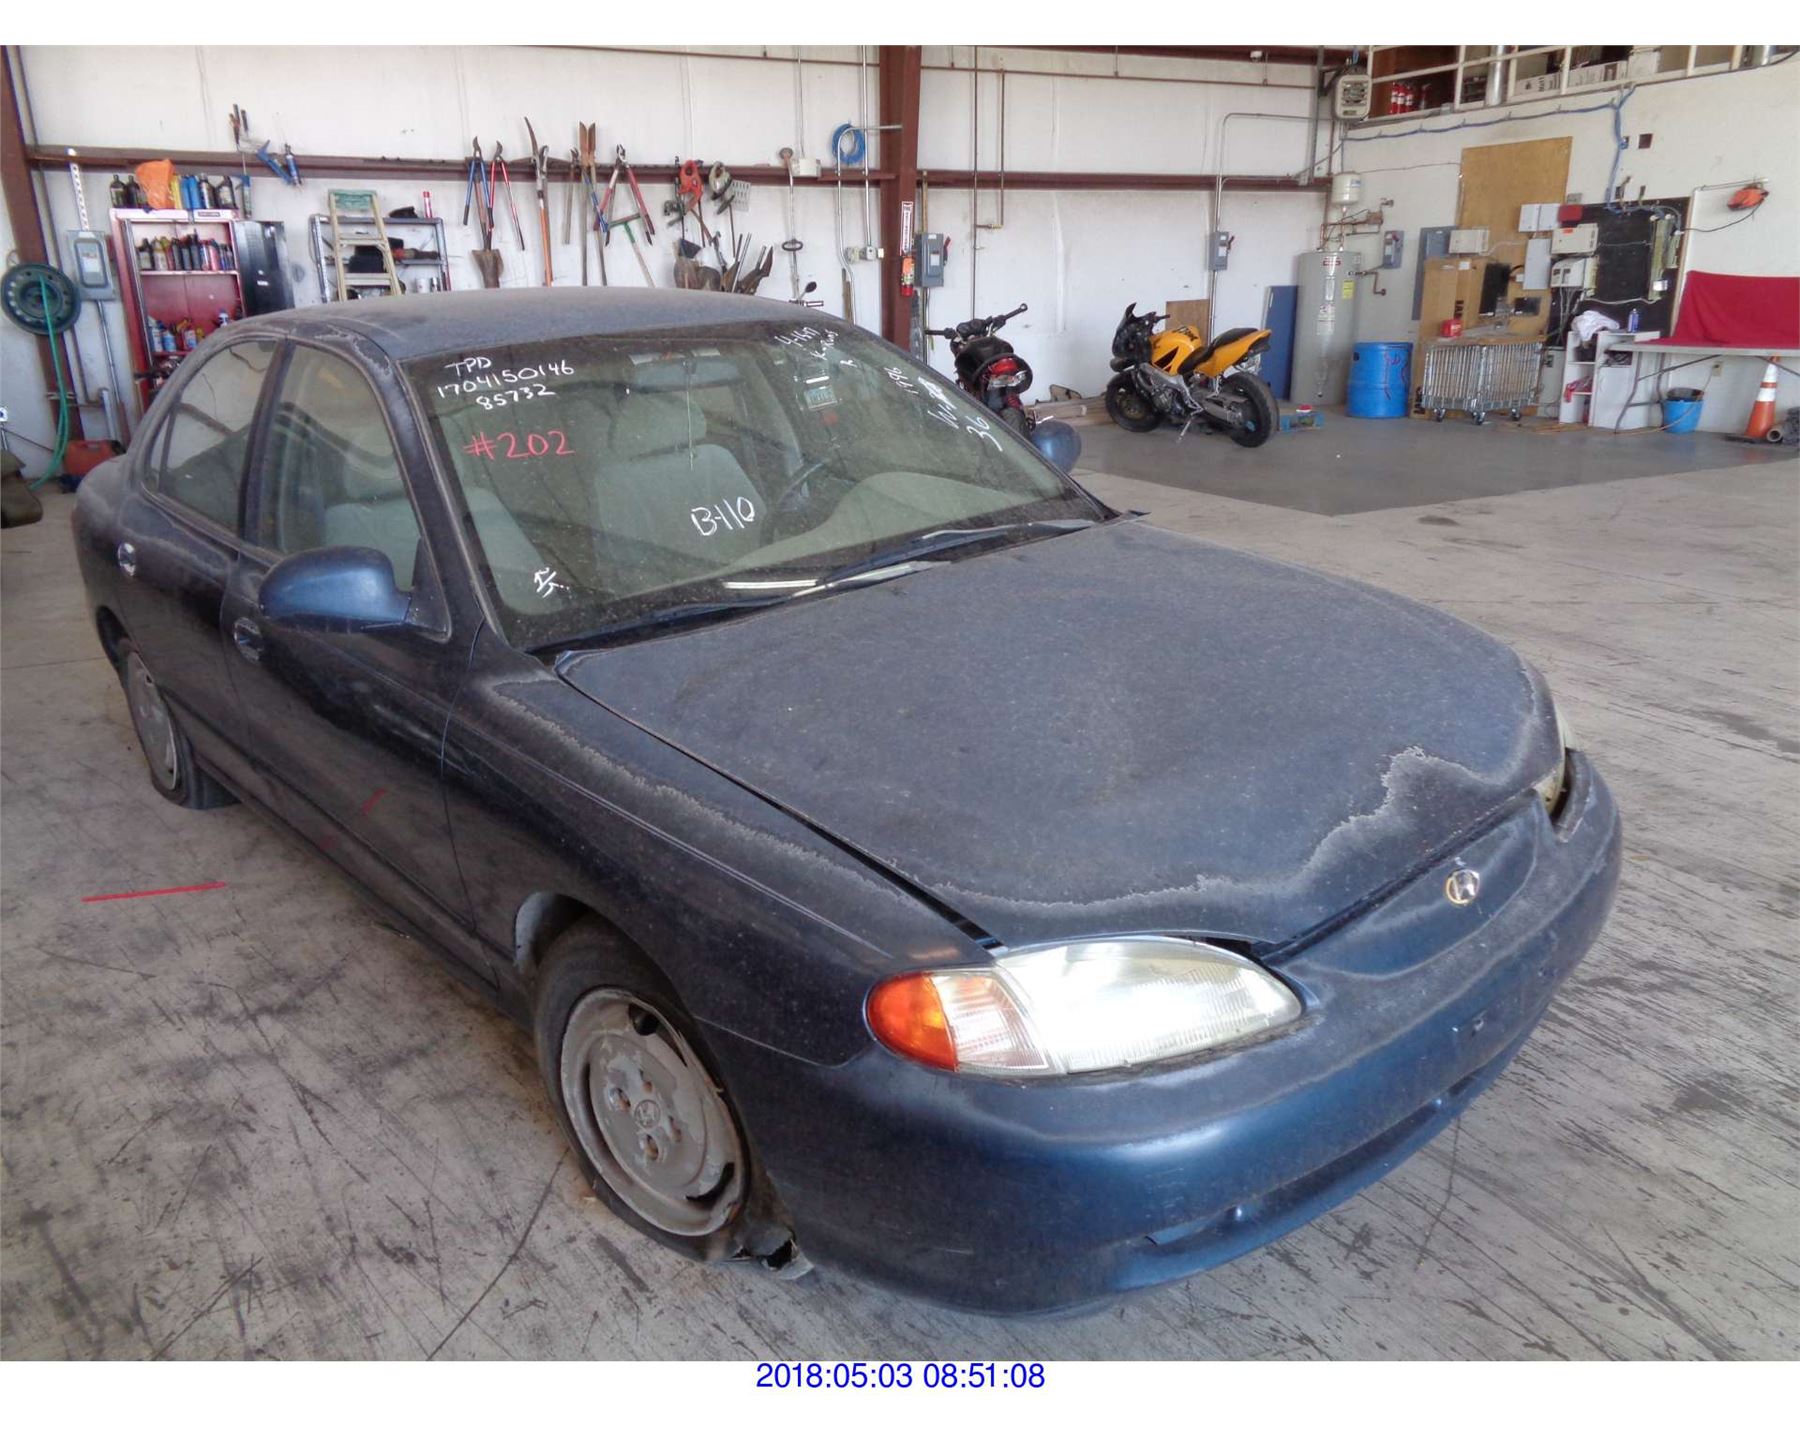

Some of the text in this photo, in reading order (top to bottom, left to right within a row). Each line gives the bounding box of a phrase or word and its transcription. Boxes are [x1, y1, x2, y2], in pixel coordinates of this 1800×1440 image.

[437, 359, 575, 398] 1704150146
[444, 356, 492, 376] TPD
[475, 383, 556, 410] 85732
[462, 431, 576, 460] #202
